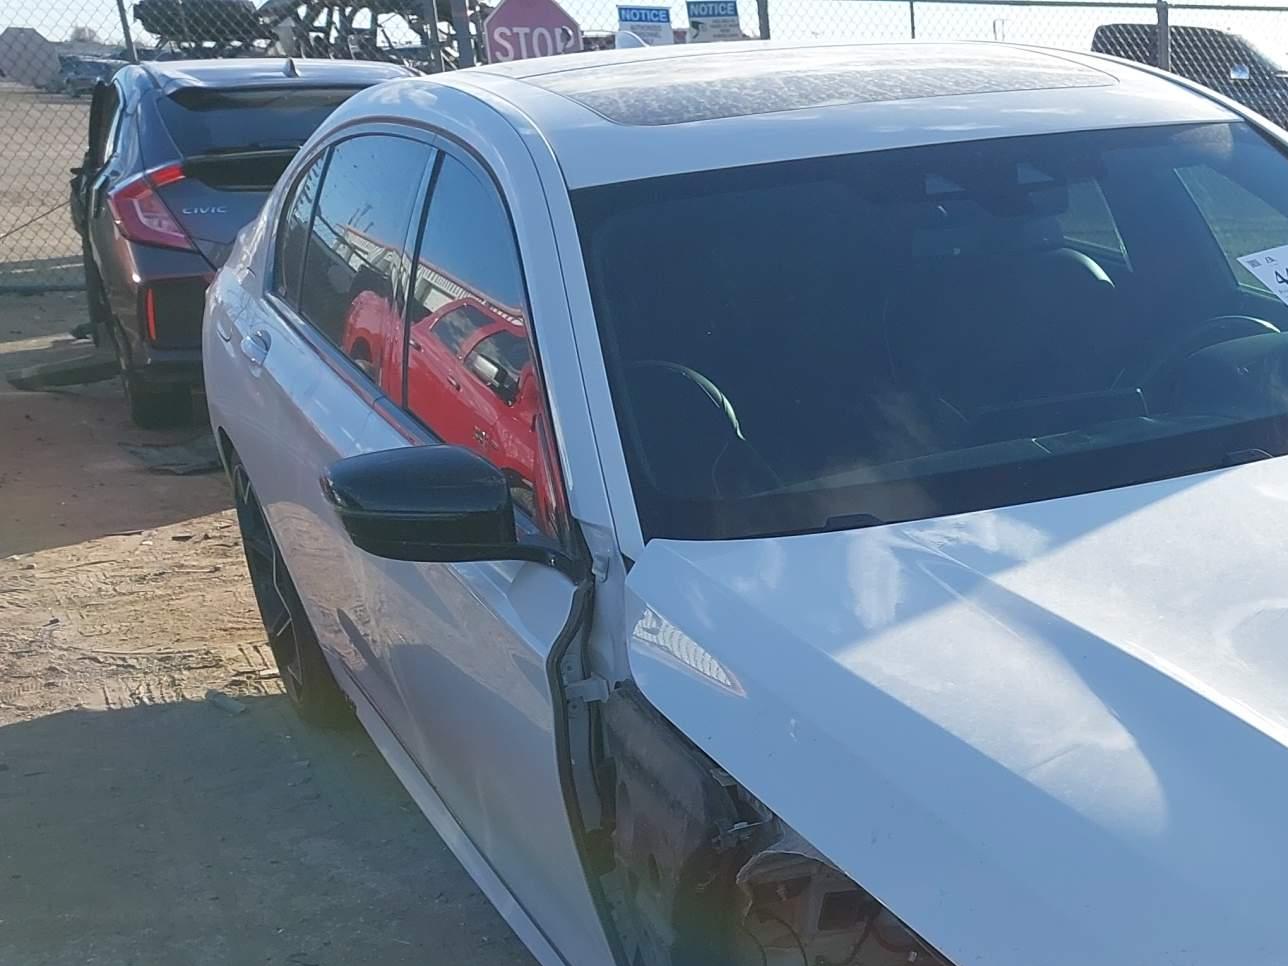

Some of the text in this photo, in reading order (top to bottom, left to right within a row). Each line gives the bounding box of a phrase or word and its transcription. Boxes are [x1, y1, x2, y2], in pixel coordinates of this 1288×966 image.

[621, 9, 667, 22] NOTICE
[690, 2, 735, 16] NOTICE
[494, 26, 575, 61] STOP
[182, 206, 227, 215] CIVIC
